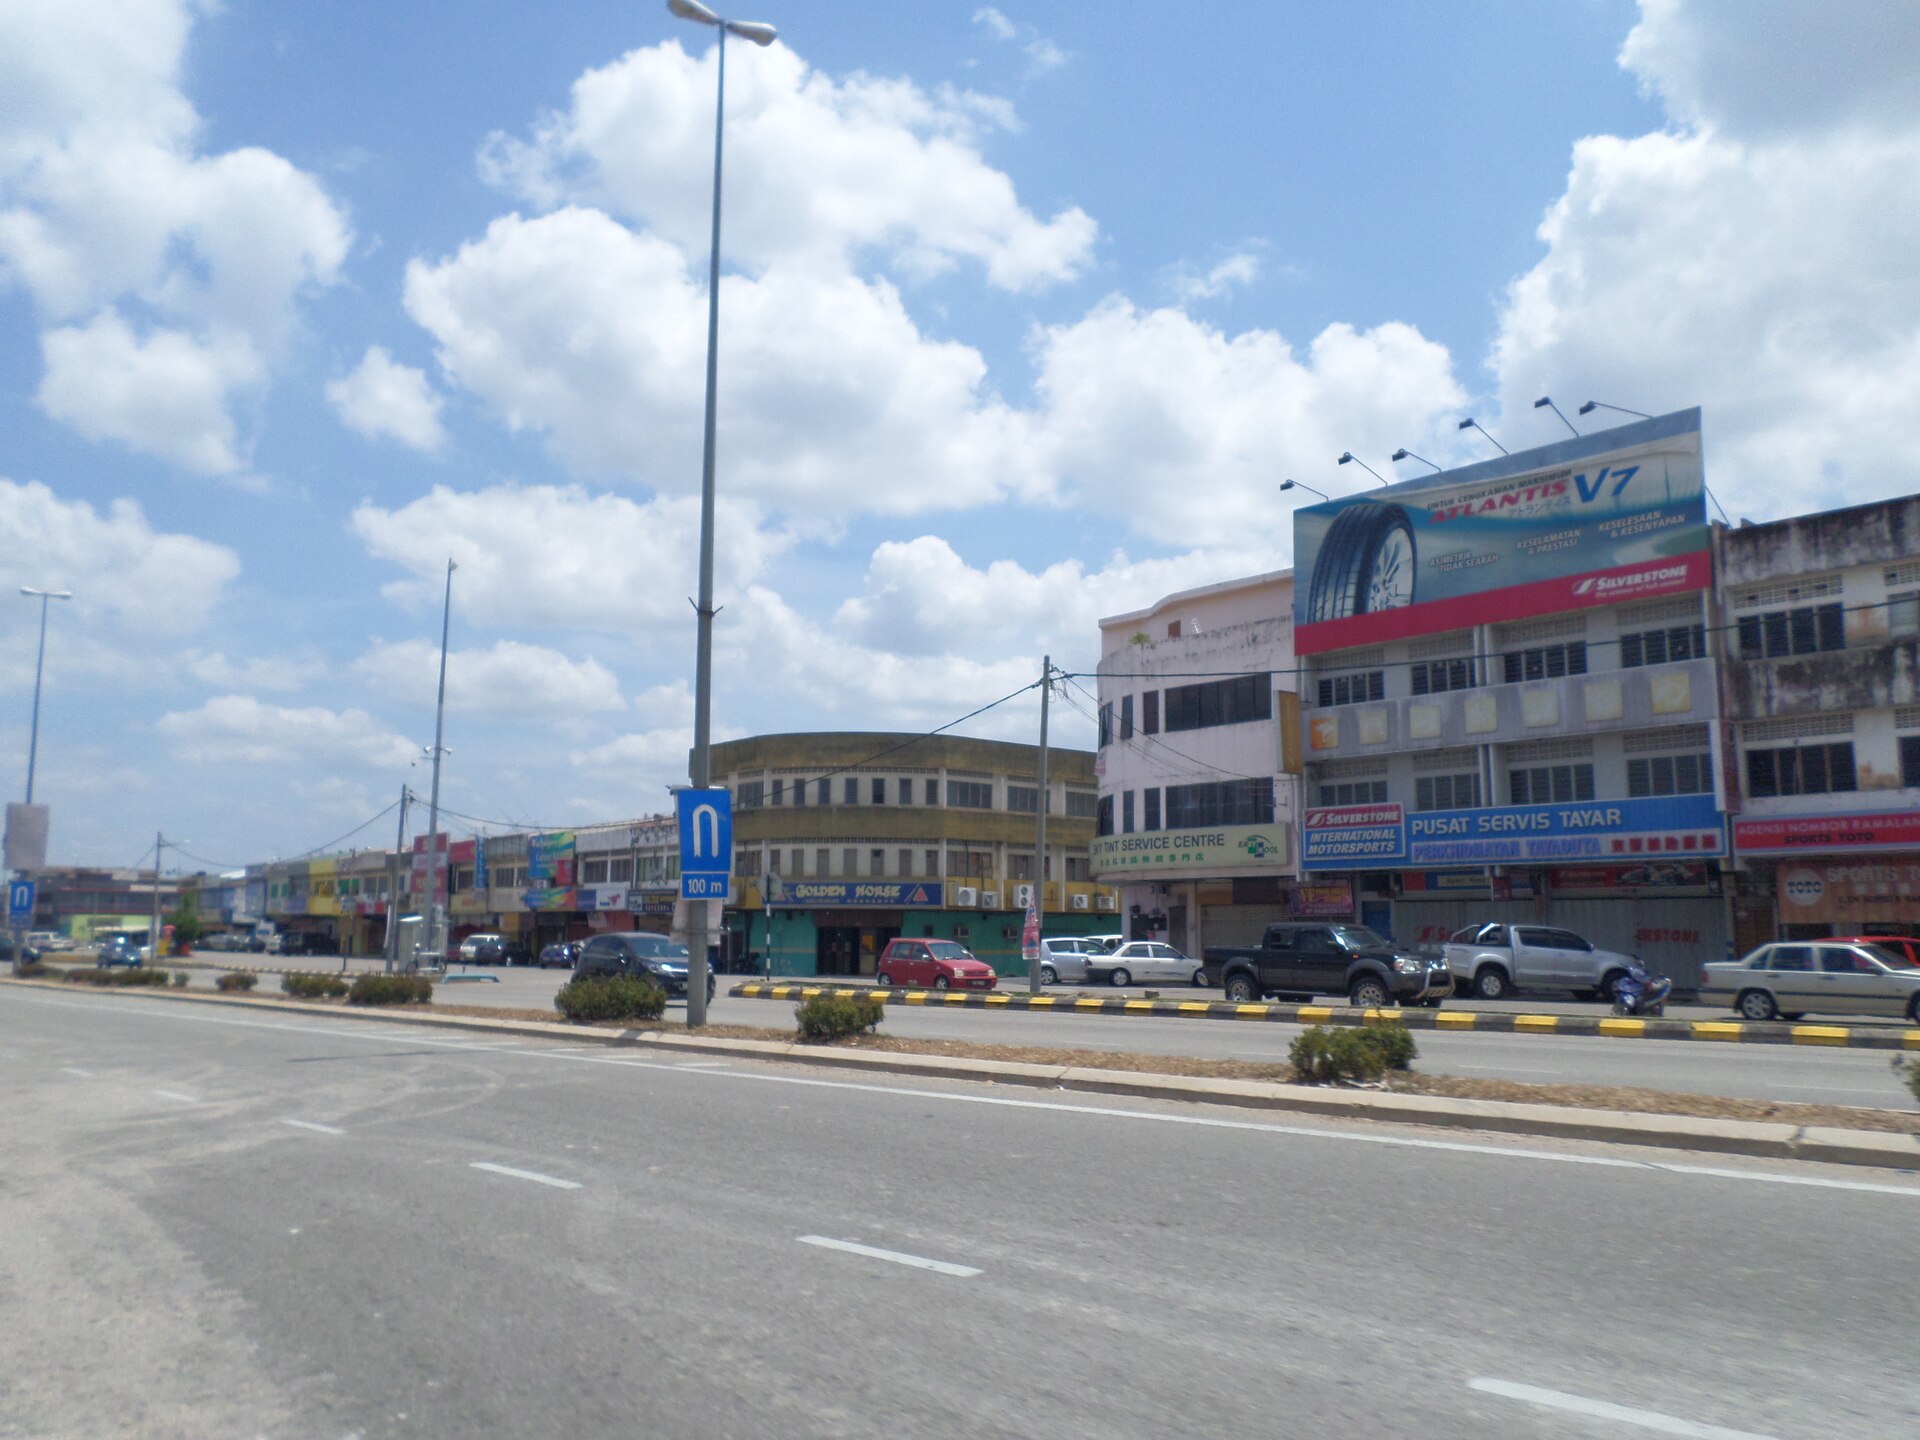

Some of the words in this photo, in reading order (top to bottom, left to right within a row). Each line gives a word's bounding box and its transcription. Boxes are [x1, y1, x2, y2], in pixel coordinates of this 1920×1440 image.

[1427, 498, 1454, 511] UNTUK
[1458, 484, 1515, 502] CENGKAMAN
[1428, 480, 1569, 525] ATLANTIS
[1574, 466, 1640, 504] V7
[1599, 510, 1661, 532] KESELESAAN
[1621, 514, 1686, 536] KESENYAPAN
[1517, 529, 1581, 550] KESELAMATAN
[1537, 539, 1578, 553] PRESTASI
[1430, 552, 1472, 567] ASIMETRIK
[1440, 561, 1464, 572] TIDAK
[1597, 565, 1687, 590] SILVERSTONE
[1326, 811, 1399, 825] SILVERSTONE
[1412, 817, 1470, 836] PUSAT
[1478, 812, 1550, 833] SERVIS
[1559, 808, 1622, 829] TAYAR
[1738, 824, 1785, 835] AGENSI
[1789, 820, 1849, 833] NOMBOR
[1122, 837, 1170, 852] SERVICE
[1173, 833, 1225, 848] CENTRE
[1310, 829, 1396, 844] INTERNATIONAL
[1784, 832, 1832, 844] SPORTS
[1838, 832, 1874, 842] TOTO
[1308, 841, 1396, 855] MOTORSPORTS
[1413, 840, 1520, 861] PERKHIDMATAN
[688, 879, 705, 894] 100
[710, 882, 722, 893] m
[796, 884, 847, 898] GOLDEN
